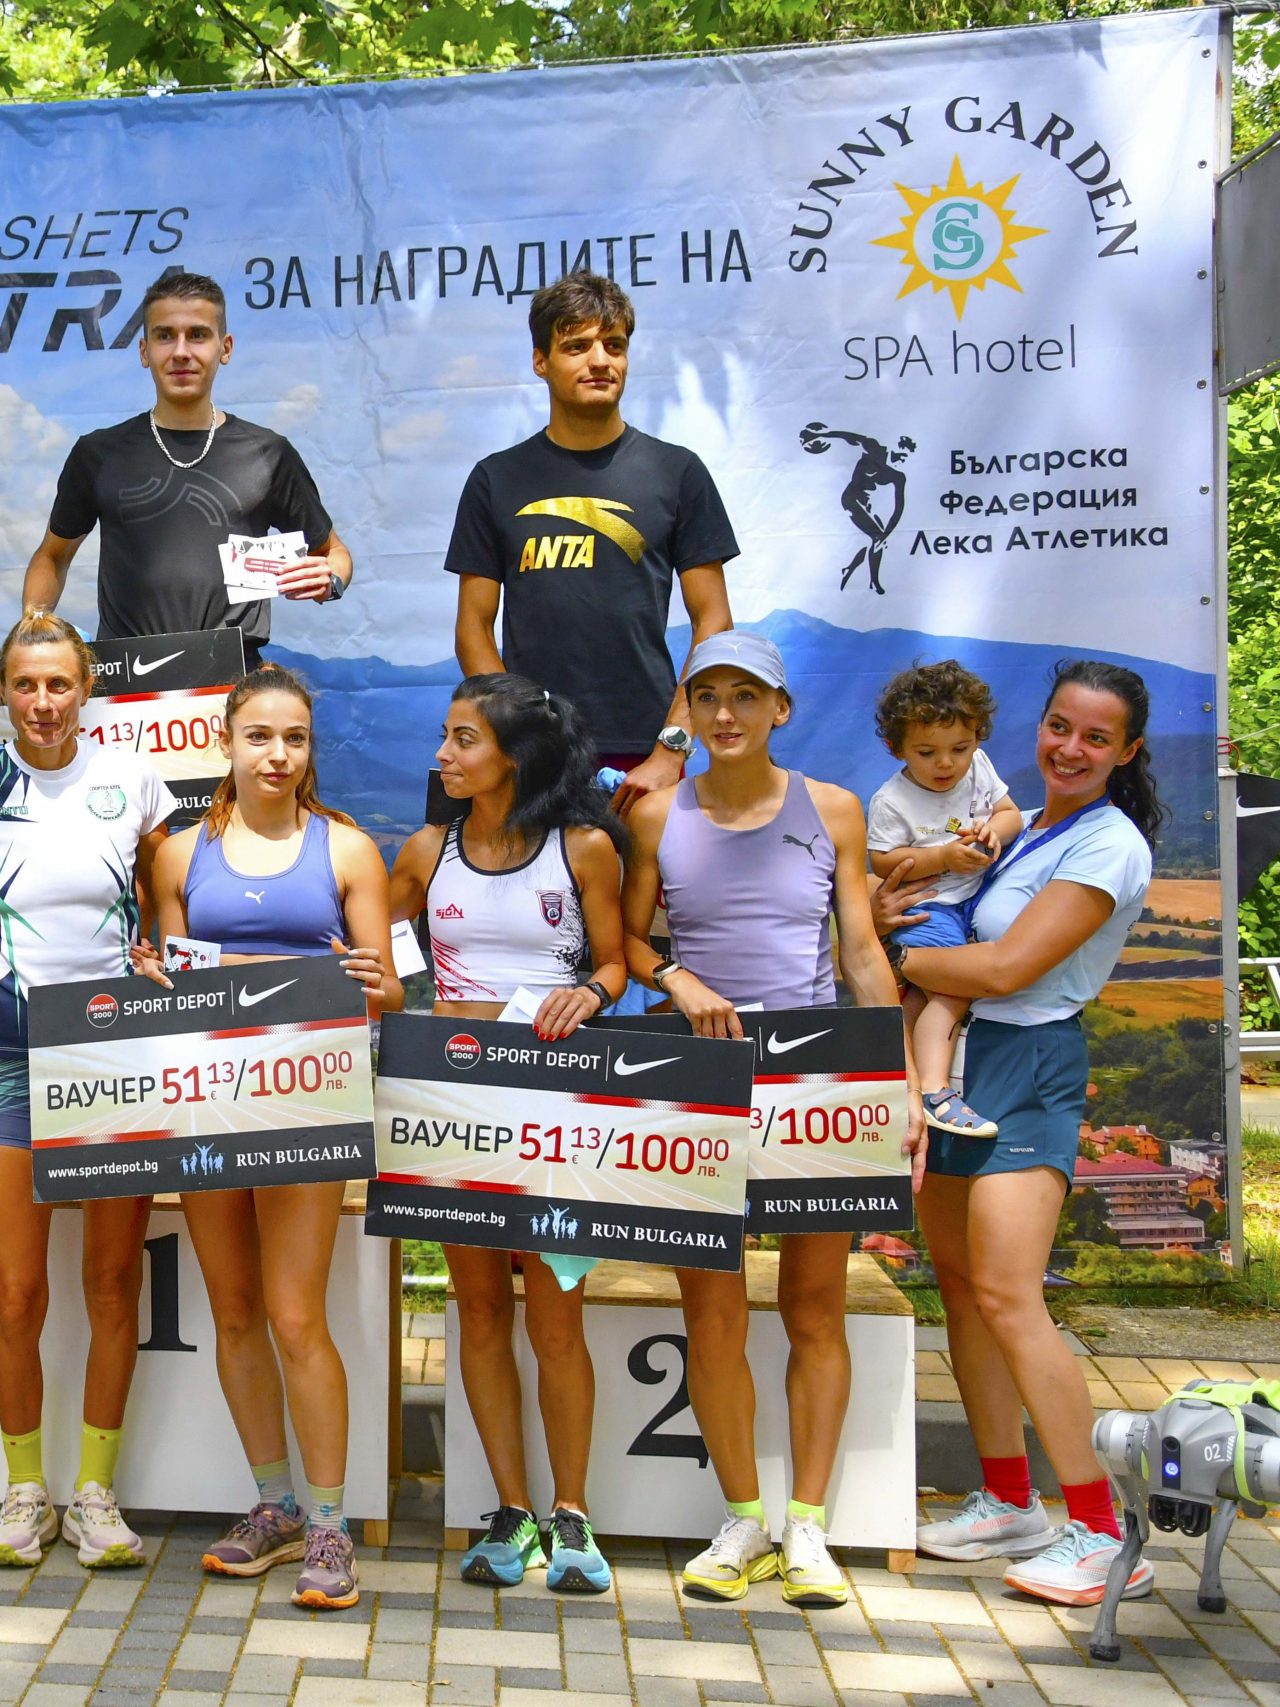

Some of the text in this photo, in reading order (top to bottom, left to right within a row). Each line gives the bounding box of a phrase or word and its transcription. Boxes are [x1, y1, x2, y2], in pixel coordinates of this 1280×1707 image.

[788, 96, 1139, 274] SUNNY GARDEN
[245, 228, 753, 310] ЗА НАГРАДИТЕ НА
[844, 323, 1076, 381] SPA hotel
[950, 447, 1128, 476] Българска
[939, 488, 1137, 516] Федерация
[519, 535, 595, 573] ANTA
[910, 526, 1168, 555] Лека Атлетика
[89, 661, 122, 676] EPOT
[89, 1002, 115, 1012] SPORT
[92, 1011, 112, 1019] 2000
[123, 992, 226, 1016] SPORT DEPOT
[449, 1043, 477, 1052] SPORT
[451, 1052, 474, 1060] 2000
[486, 1046, 601, 1071] SPORT DEPOT
[47, 1075, 156, 1110] ВАУЧЕР
[390, 1116, 514, 1154] ВАУЧЕР
[48, 1145, 362, 1179] www.sportdepot.bg RUN BULGARIA
[764, 1197, 899, 1213] RUN BULGARIA
[383, 1203, 727, 1249] www.sportdepot.bg RUN BULGARIA
[627, 1334, 708, 1469] 2
[1204, 1443, 1221, 1462] 02
